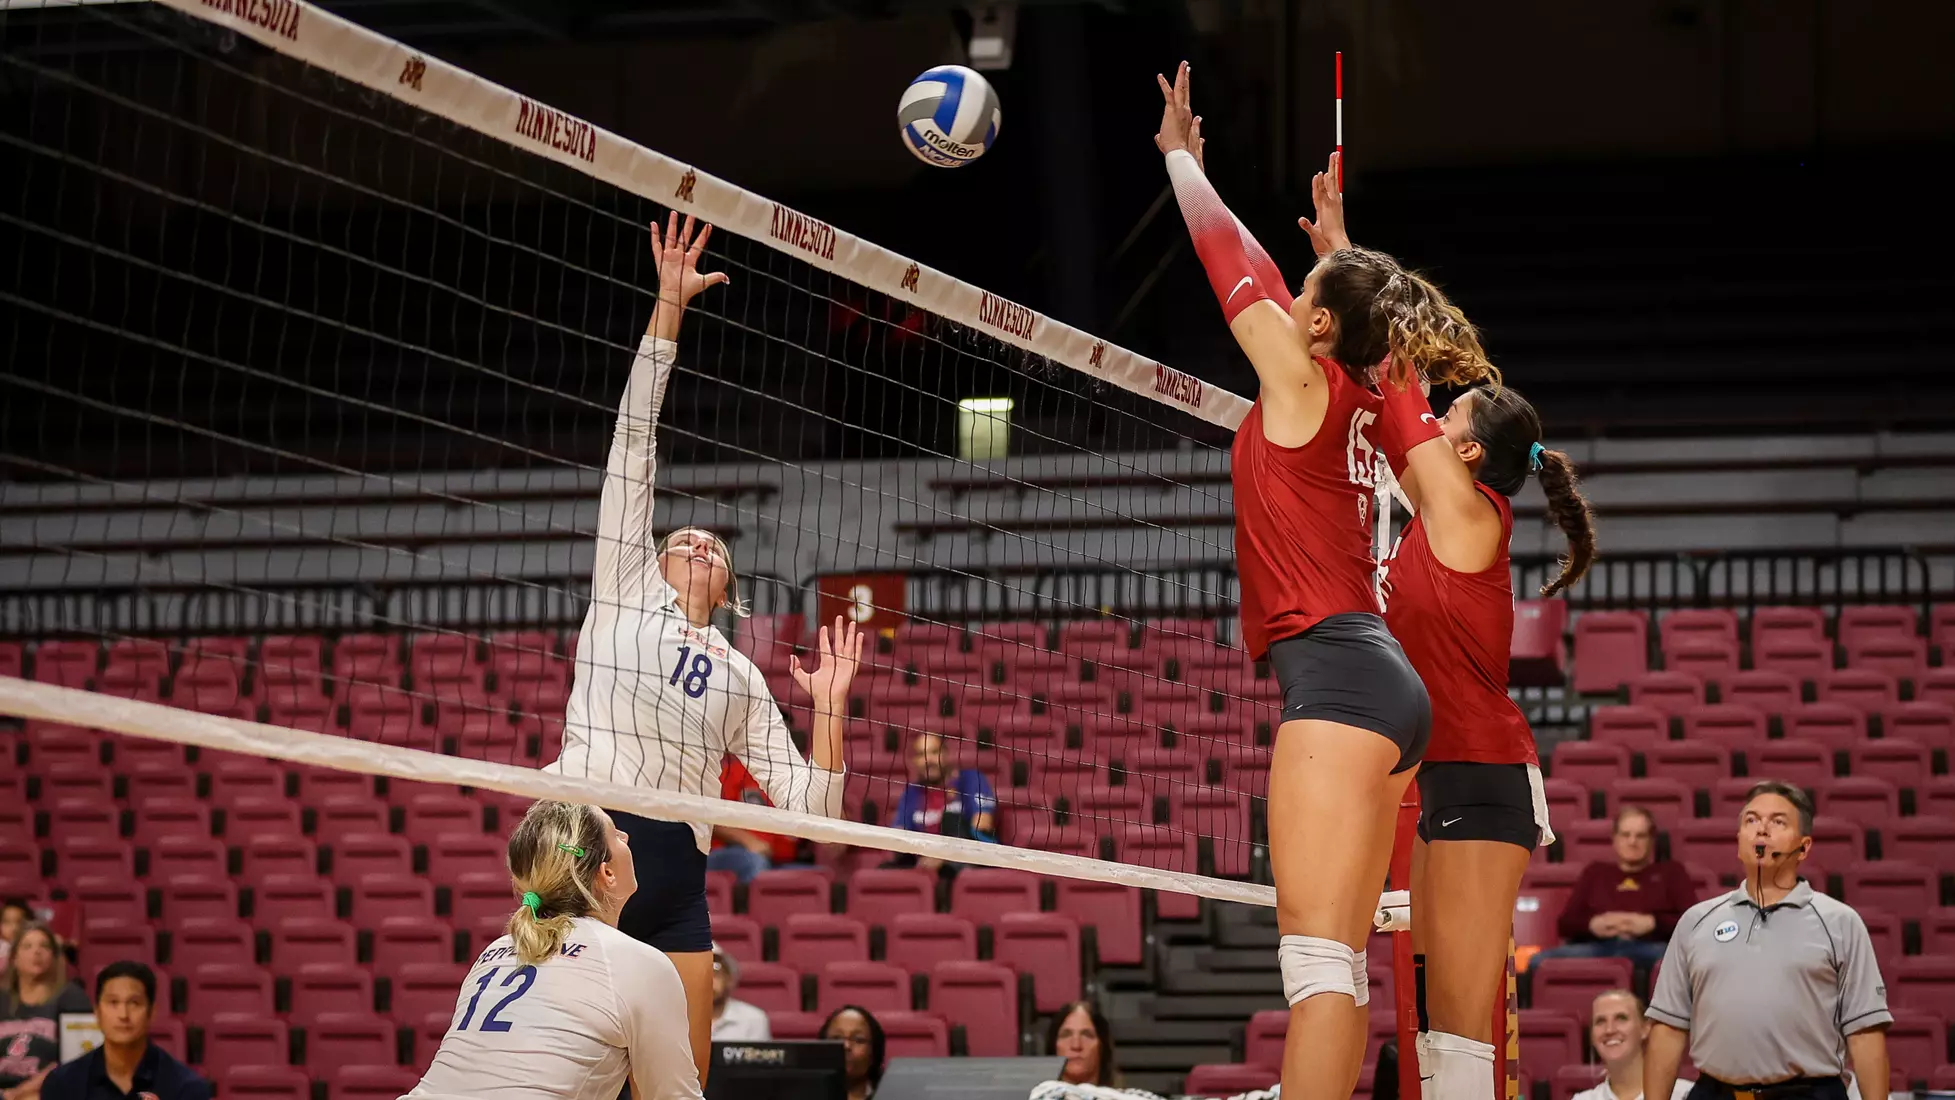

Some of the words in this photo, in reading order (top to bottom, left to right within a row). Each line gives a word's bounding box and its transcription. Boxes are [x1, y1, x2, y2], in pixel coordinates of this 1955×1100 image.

[201, 0, 300, 41] ESOTA
[516, 97, 597, 163] MINNESOTA
[923, 129, 976, 159] molten
[771, 203, 836, 261] MINNESOTA
[979, 290, 1035, 341] MINNESOTA
[1155, 362, 1202, 409] MINNESOTA
[1346, 407, 1377, 488] 15
[848, 584, 875, 623] 3
[669, 646, 713, 699] 18
[457, 964, 538, 1032] 12
